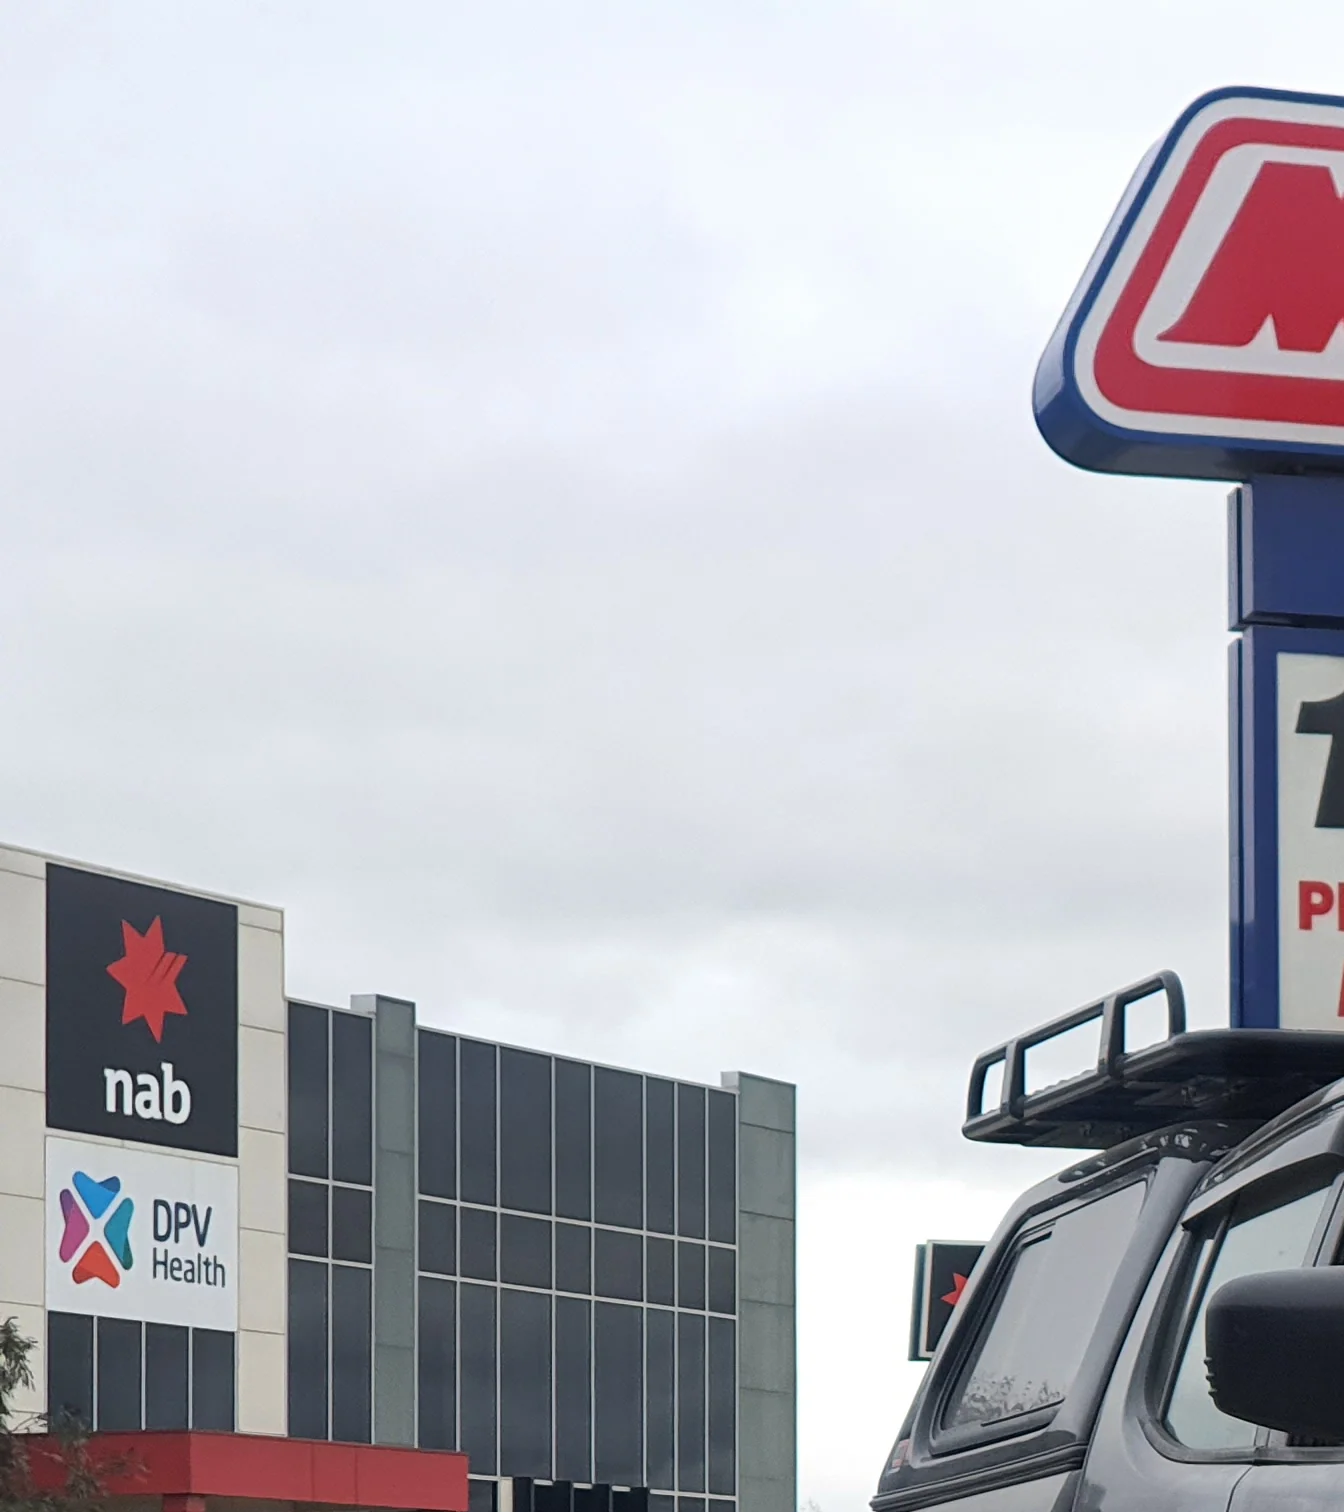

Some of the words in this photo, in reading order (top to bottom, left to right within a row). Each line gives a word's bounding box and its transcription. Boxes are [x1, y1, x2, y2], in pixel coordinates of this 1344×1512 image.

[104, 1062, 191, 1125] nab
[153, 1199, 212, 1248] DPV
[152, 1247, 226, 1289] Health
